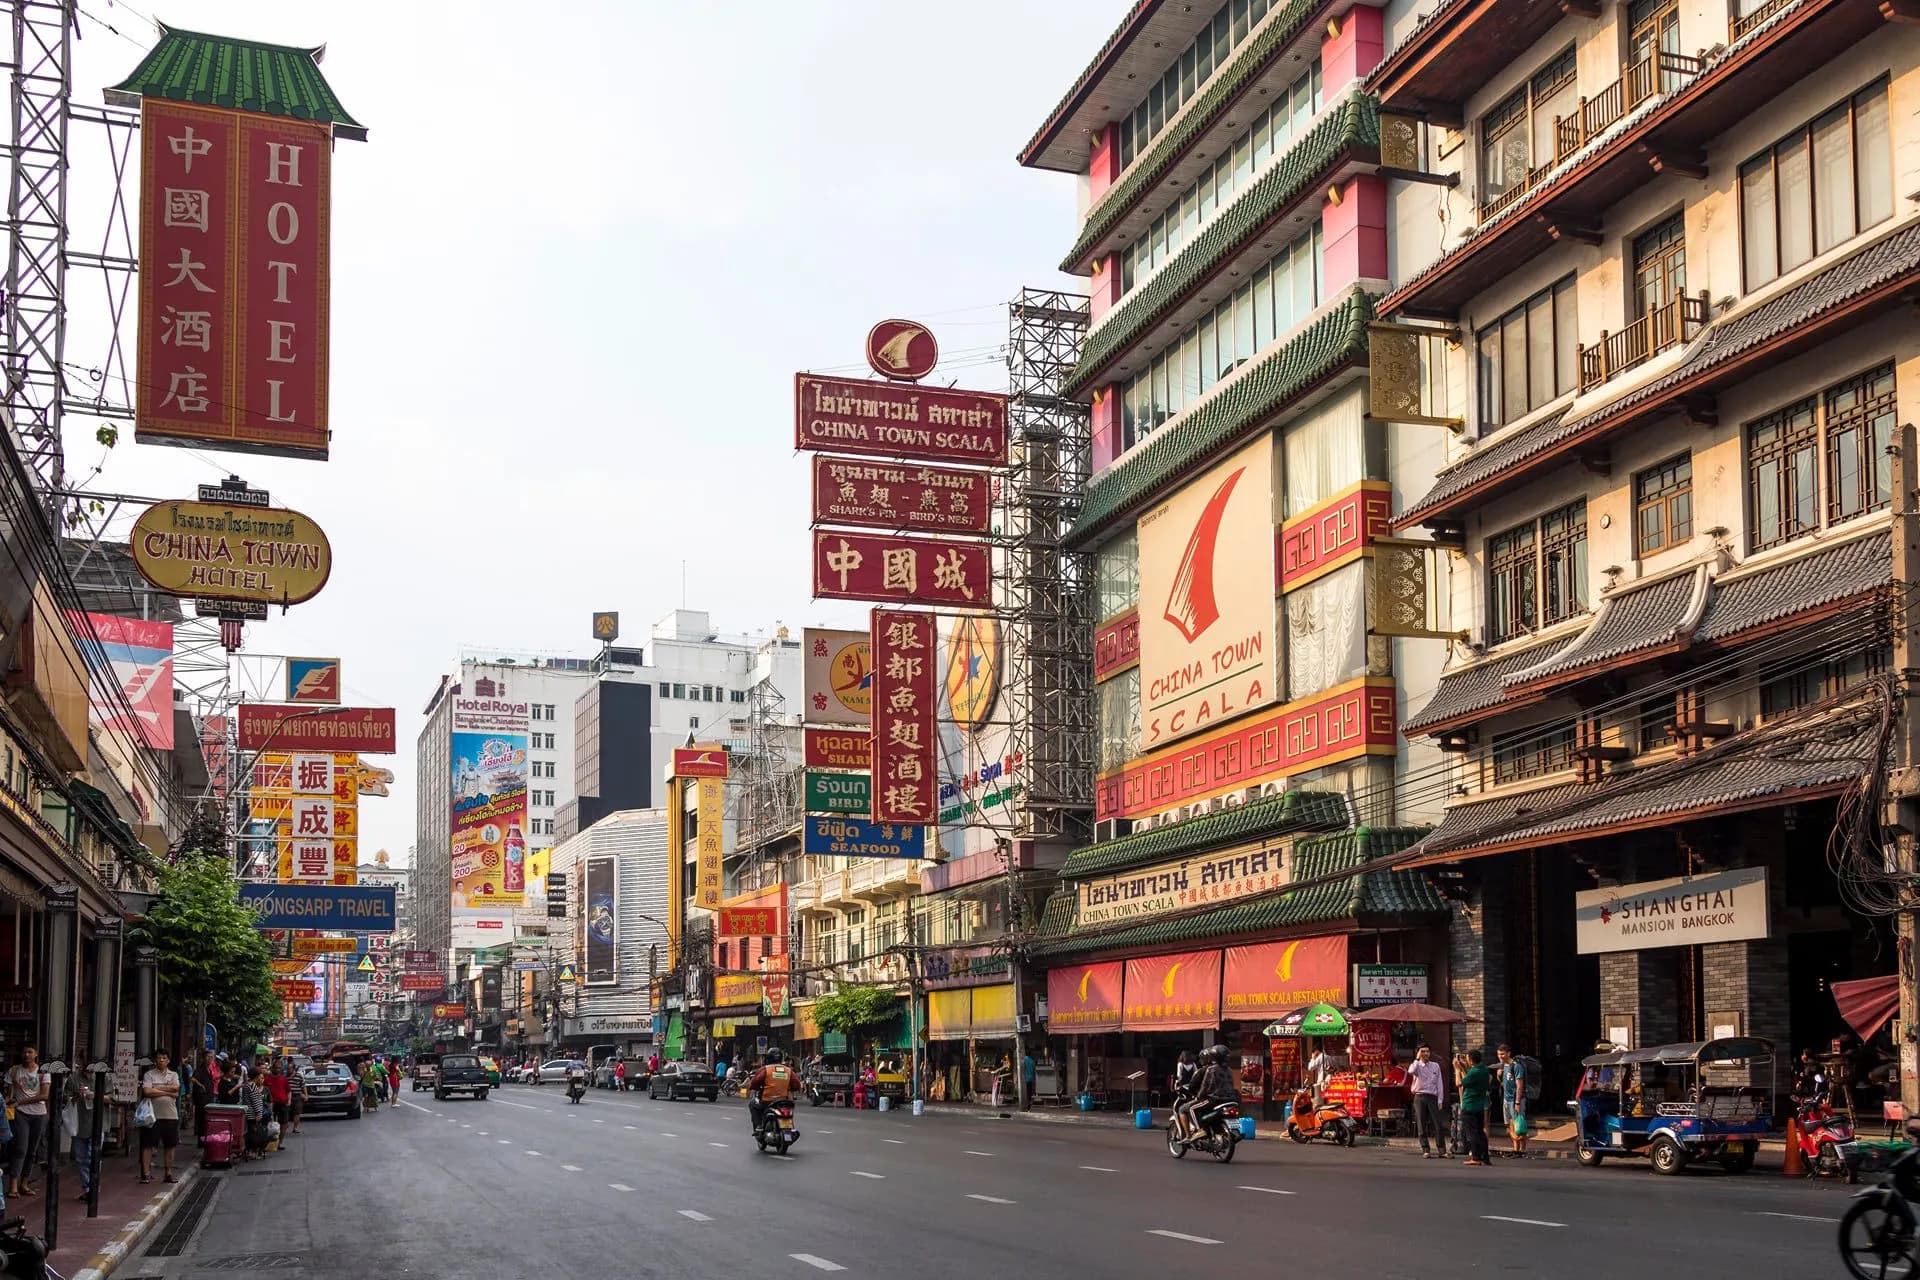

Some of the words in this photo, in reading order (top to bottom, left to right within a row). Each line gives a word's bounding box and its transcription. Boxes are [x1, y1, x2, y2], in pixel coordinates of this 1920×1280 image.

[159, 126, 216, 415] 中國大酒店
[264, 141, 305, 423] HOTEL
[811, 384, 919, 422] ไชน่าทาวน์
[928, 402, 993, 428] สกาล่า
[811, 420, 869, 441] CHINA
[875, 426, 931, 446] TOWN
[935, 434, 995, 452] SCALA
[829, 505, 875, 518] SHARK'S
[879, 508, 896, 519] FIN
[909, 511, 945, 523] BIRD'S
[948, 515, 975, 526] NEST
[144, 532, 233, 563] CHINA
[242, 540, 321, 571] TOWN
[190, 565, 274, 592] HOTEL
[826, 539, 973, 600] 中國城
[1150, 659, 1203, 701] CHINA
[1212, 631, 1262, 670] TOWN
[456, 699, 490, 711] Hotel
[492, 701, 528, 715] Royal
[842, 695, 864, 705] NAM
[1150, 679, 1263, 742] SCALA
[883, 621, 927, 816] 銀都魚翅酒樓
[816, 776, 866, 794] รังนก
[828, 798, 863, 808] BIRD
[298, 760, 329, 876] 振成豐
[830, 843, 900, 855] SEAFOOD
[454, 867, 470, 878] 200
[1085, 861, 1189, 907] ไชน่าทาวน์
[1201, 841, 1283, 885] สกาล่า
[338, 898, 390, 918] TRAVEL
[1083, 907, 1110, 923] CHINA
[1113, 902, 1140, 918] TOWN
[1142, 896, 1174, 913] SCALA
[1621, 888, 1735, 919] SHANGHAI
[1621, 919, 1675, 935] MANSION
[1681, 912, 1735, 929] BANGKOK
[1227, 993, 1247, 1006] CHINA
[1249, 992, 1269, 1005] TOWN
[1270, 991, 1291, 1005] SCALA
[1293, 988, 1341, 1004] RESTAURANT
[1358, 1029, 1386, 1042] เกาลัด
